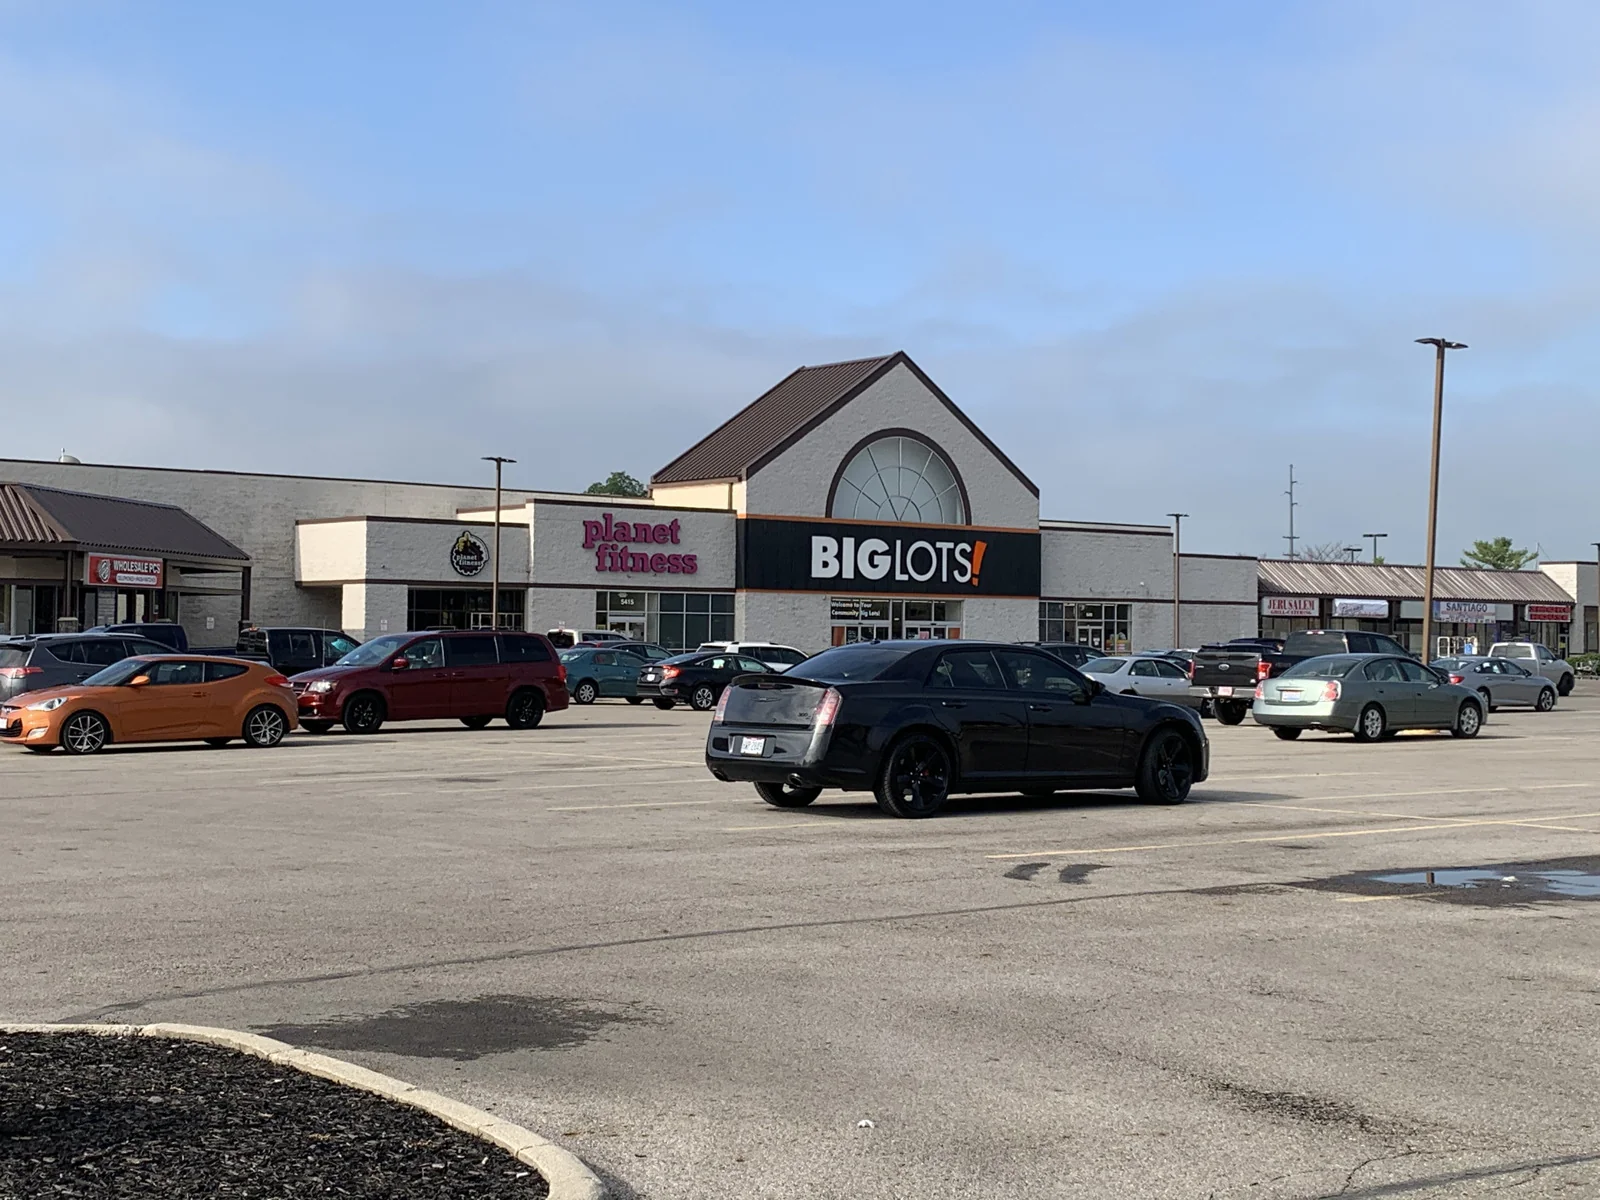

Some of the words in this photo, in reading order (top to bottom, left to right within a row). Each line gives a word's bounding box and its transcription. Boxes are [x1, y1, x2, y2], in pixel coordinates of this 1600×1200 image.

[582, 513, 680, 549] planet
[596, 543, 698, 574] fitness
[114, 560, 149, 573] WHOLESALE
[149, 563, 161, 574] PCS
[1267, 599, 1315, 611] JERUSALEM
[1446, 602, 1488, 613] SANTIAGO
[831, 609, 859, 617] Community
